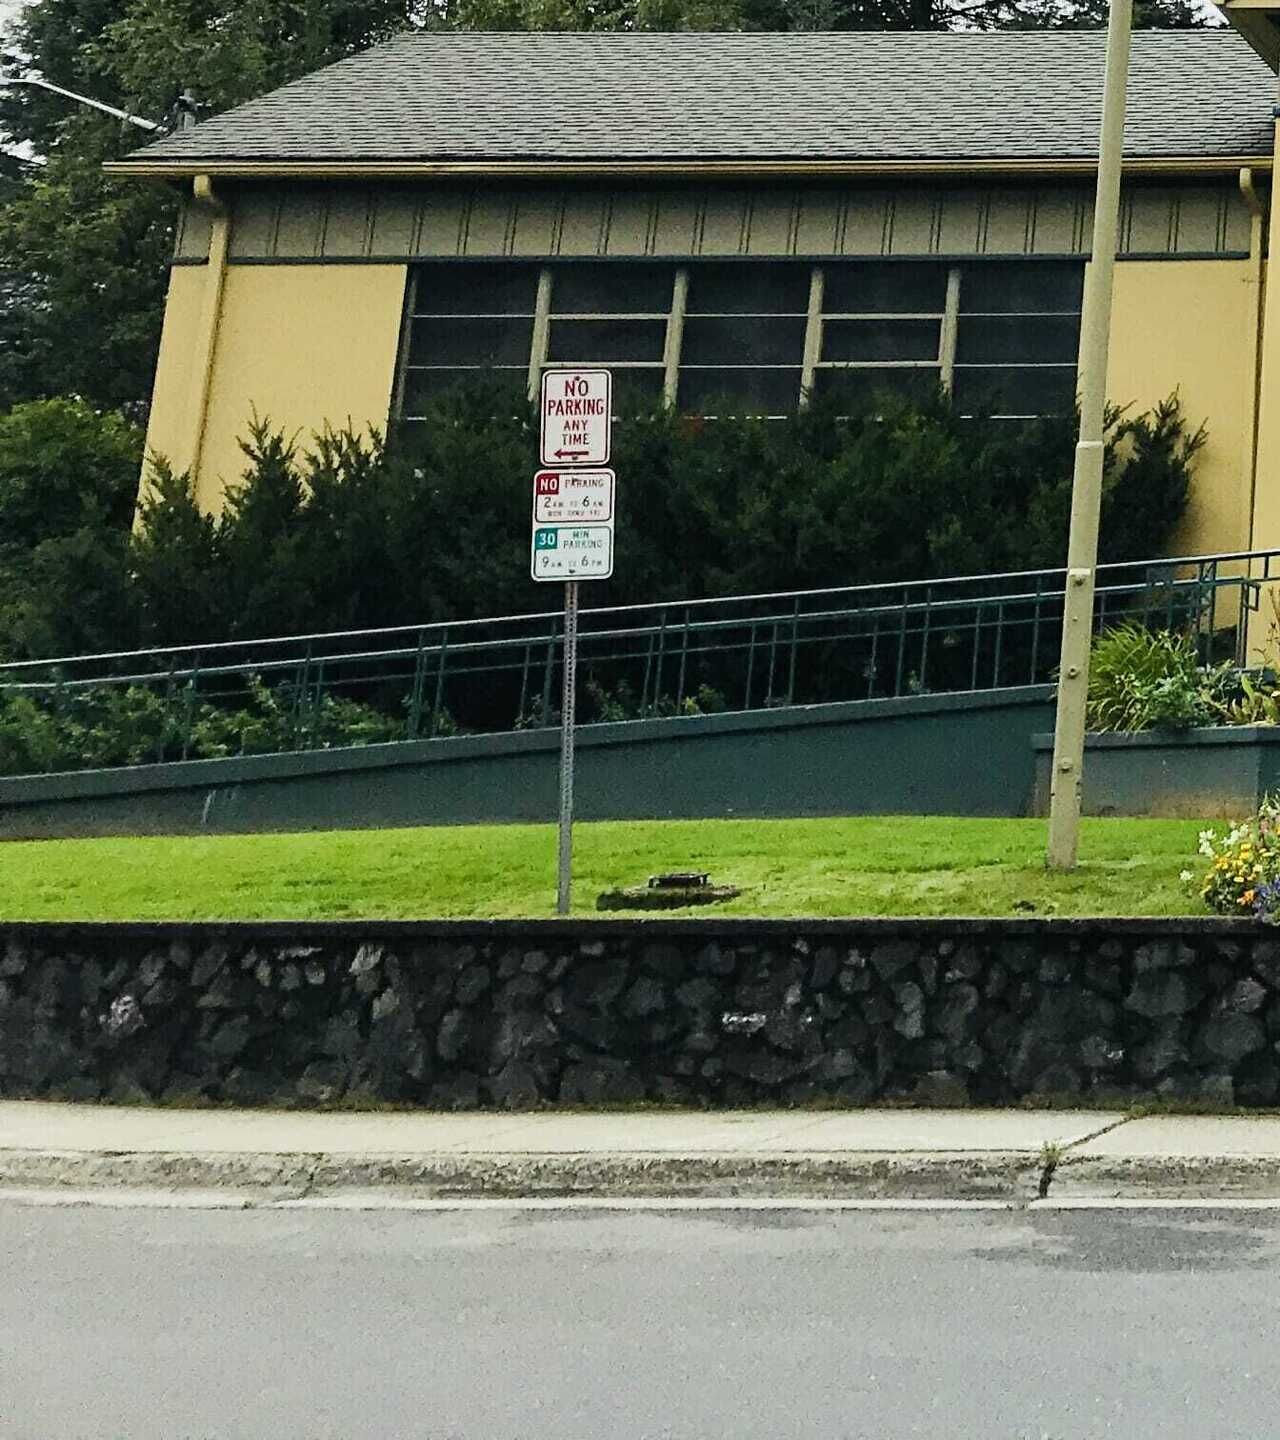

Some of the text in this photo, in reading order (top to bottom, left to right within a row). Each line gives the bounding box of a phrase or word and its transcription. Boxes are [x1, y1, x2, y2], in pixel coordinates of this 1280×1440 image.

[564, 379, 589, 397] NO
[547, 398, 604, 416] PARKING
[563, 419, 588, 431] ANY
[562, 433, 590, 446] TIME
[540, 478, 558, 491] NO
[538, 533, 556, 545] 30
